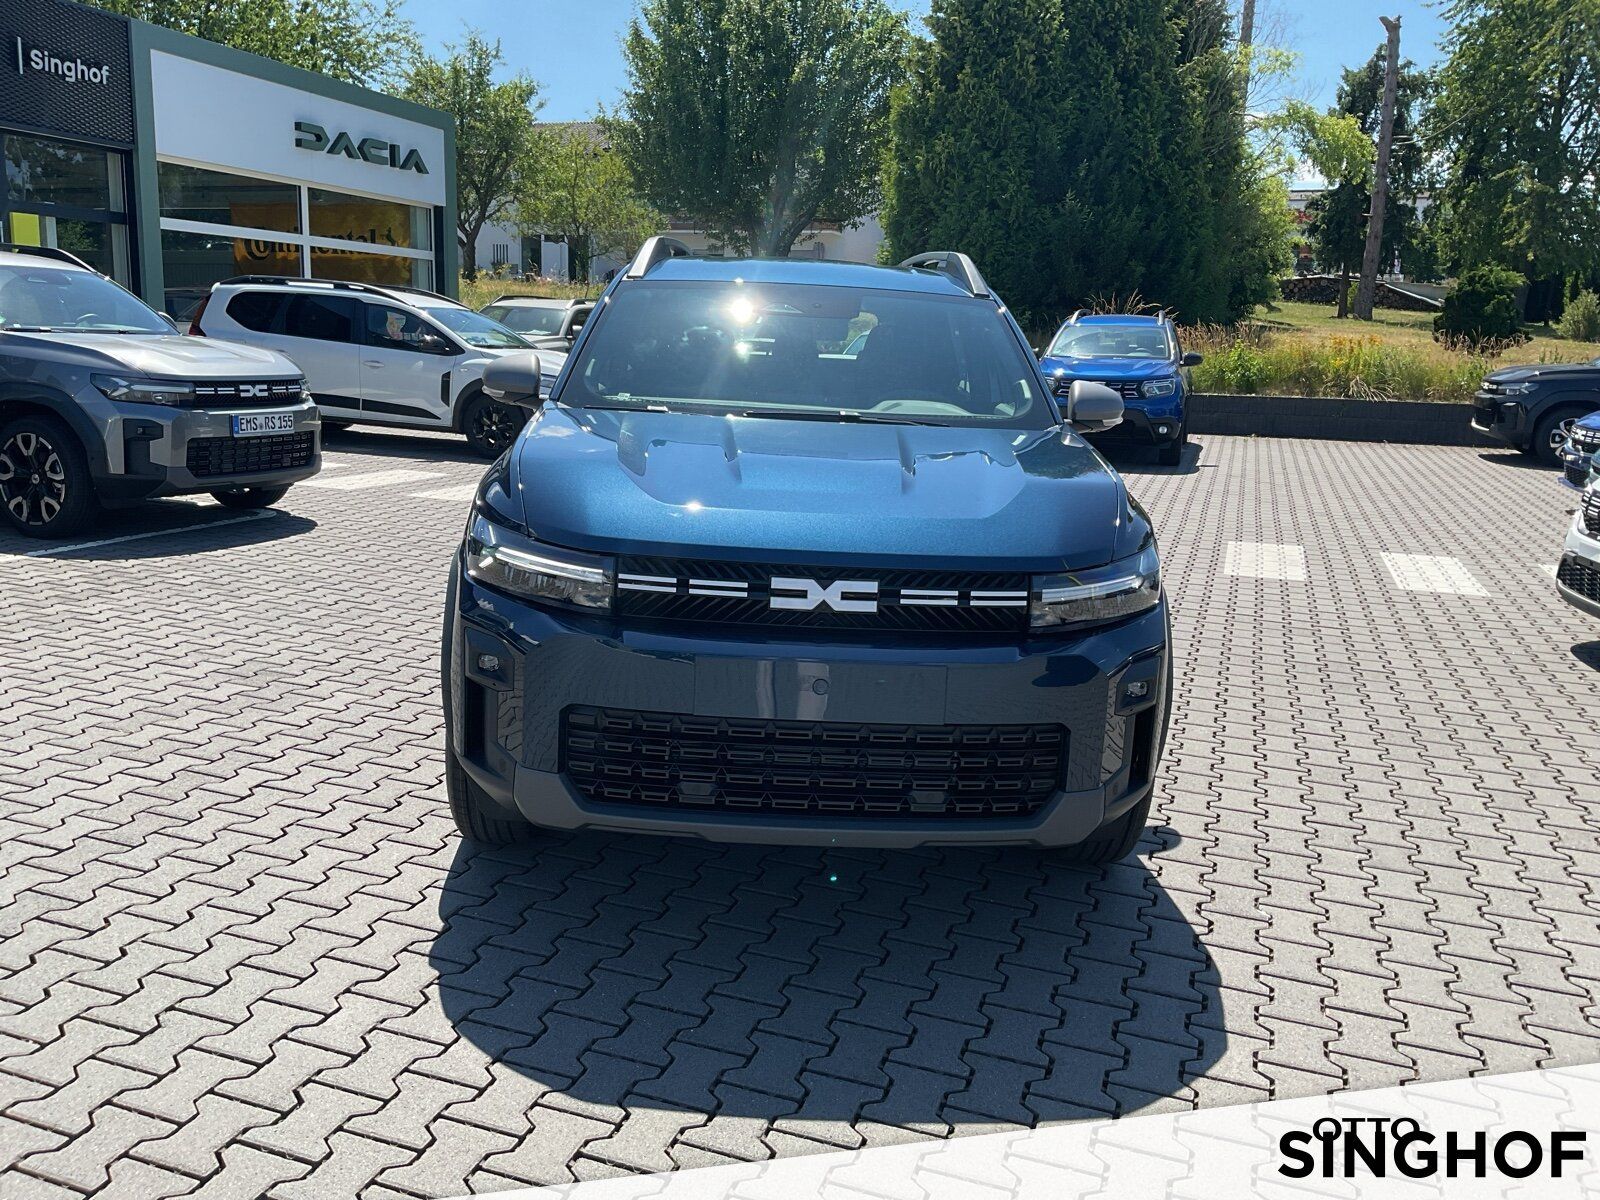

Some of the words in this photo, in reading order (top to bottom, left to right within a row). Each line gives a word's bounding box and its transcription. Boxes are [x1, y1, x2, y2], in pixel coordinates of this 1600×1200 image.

[30, 49, 109, 85] Singhof
[294, 121, 430, 174] DACIA
[243, 226, 377, 260] Coniental
[239, 417, 258, 432] EMS
